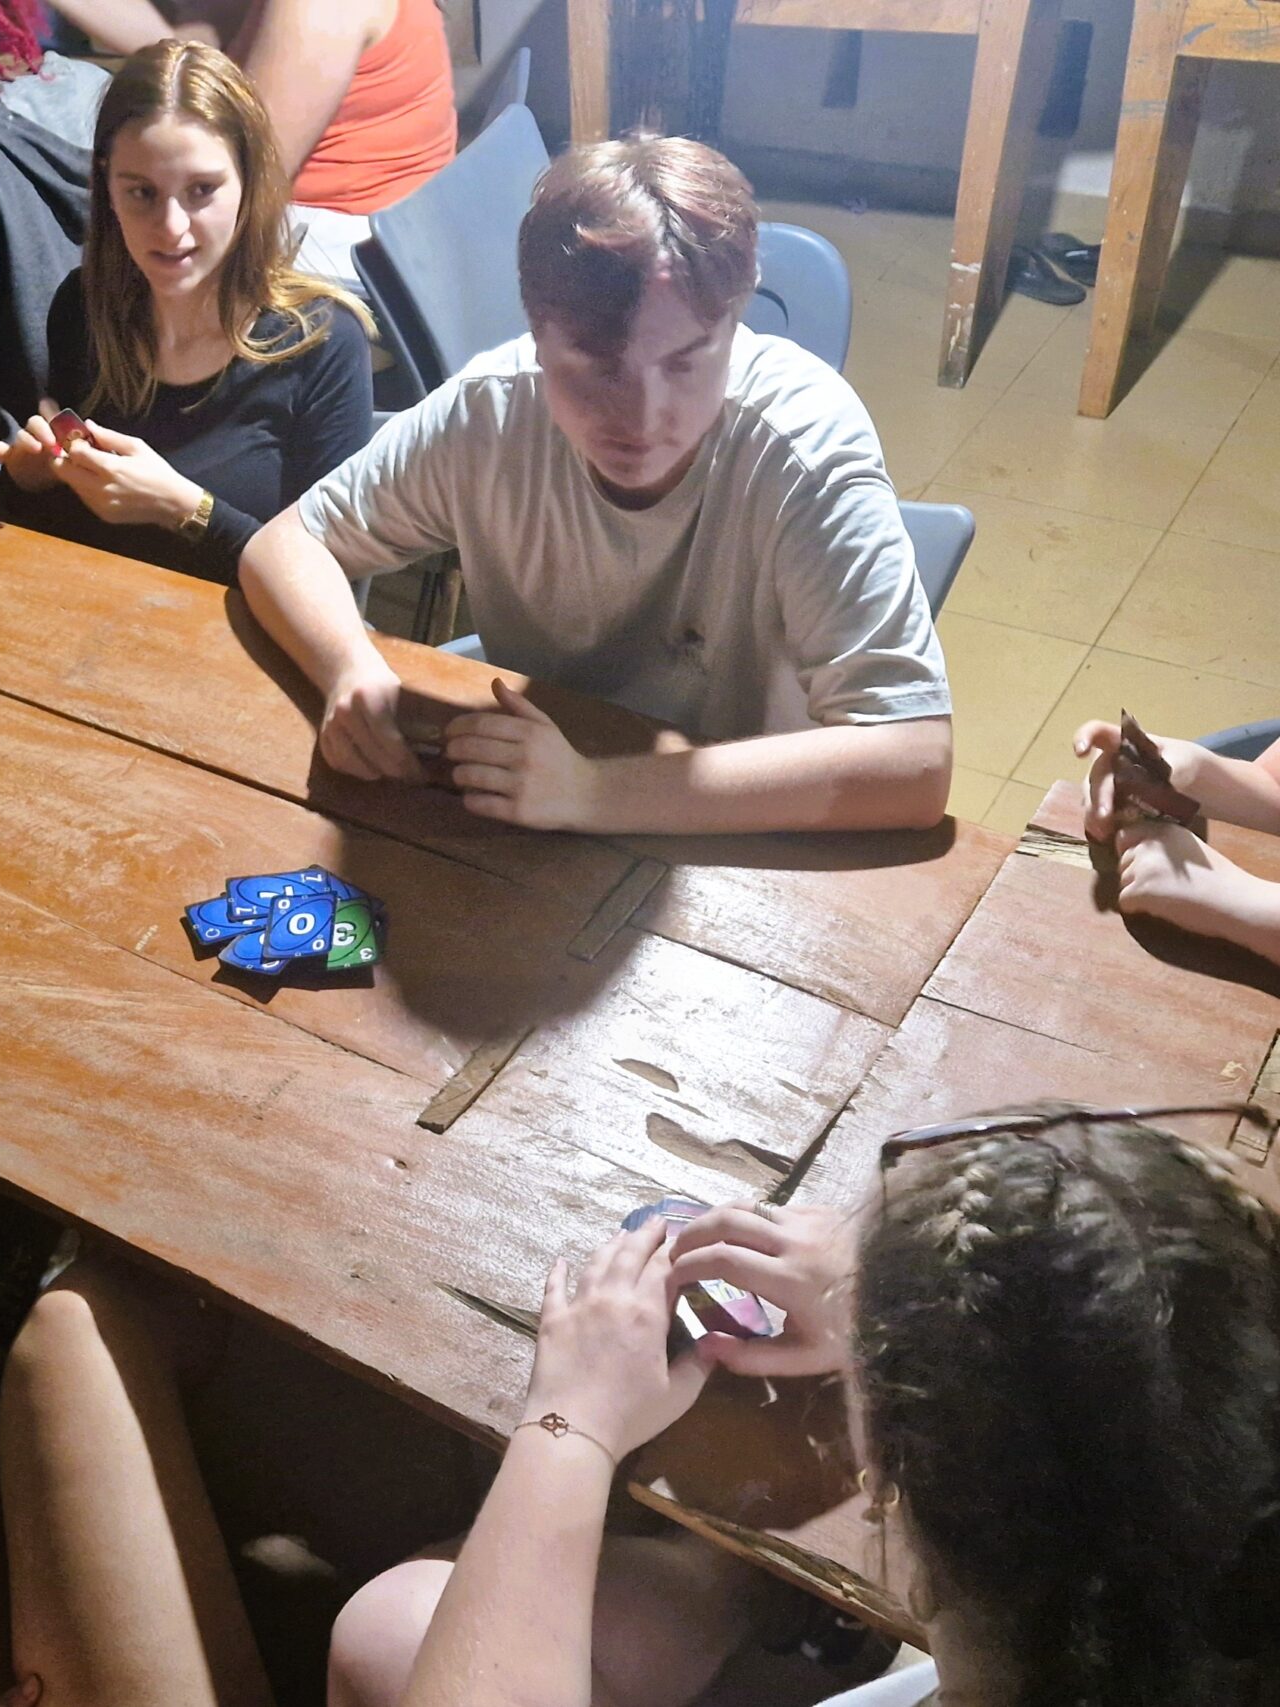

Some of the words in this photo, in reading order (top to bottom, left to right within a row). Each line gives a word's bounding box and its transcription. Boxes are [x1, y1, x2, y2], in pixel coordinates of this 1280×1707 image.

[278, 899, 291, 910] 0
[288, 913, 315, 935] 0
[333, 922, 355, 946] 3
[312, 939, 325, 950] 0
[360, 947, 373, 960] 3
